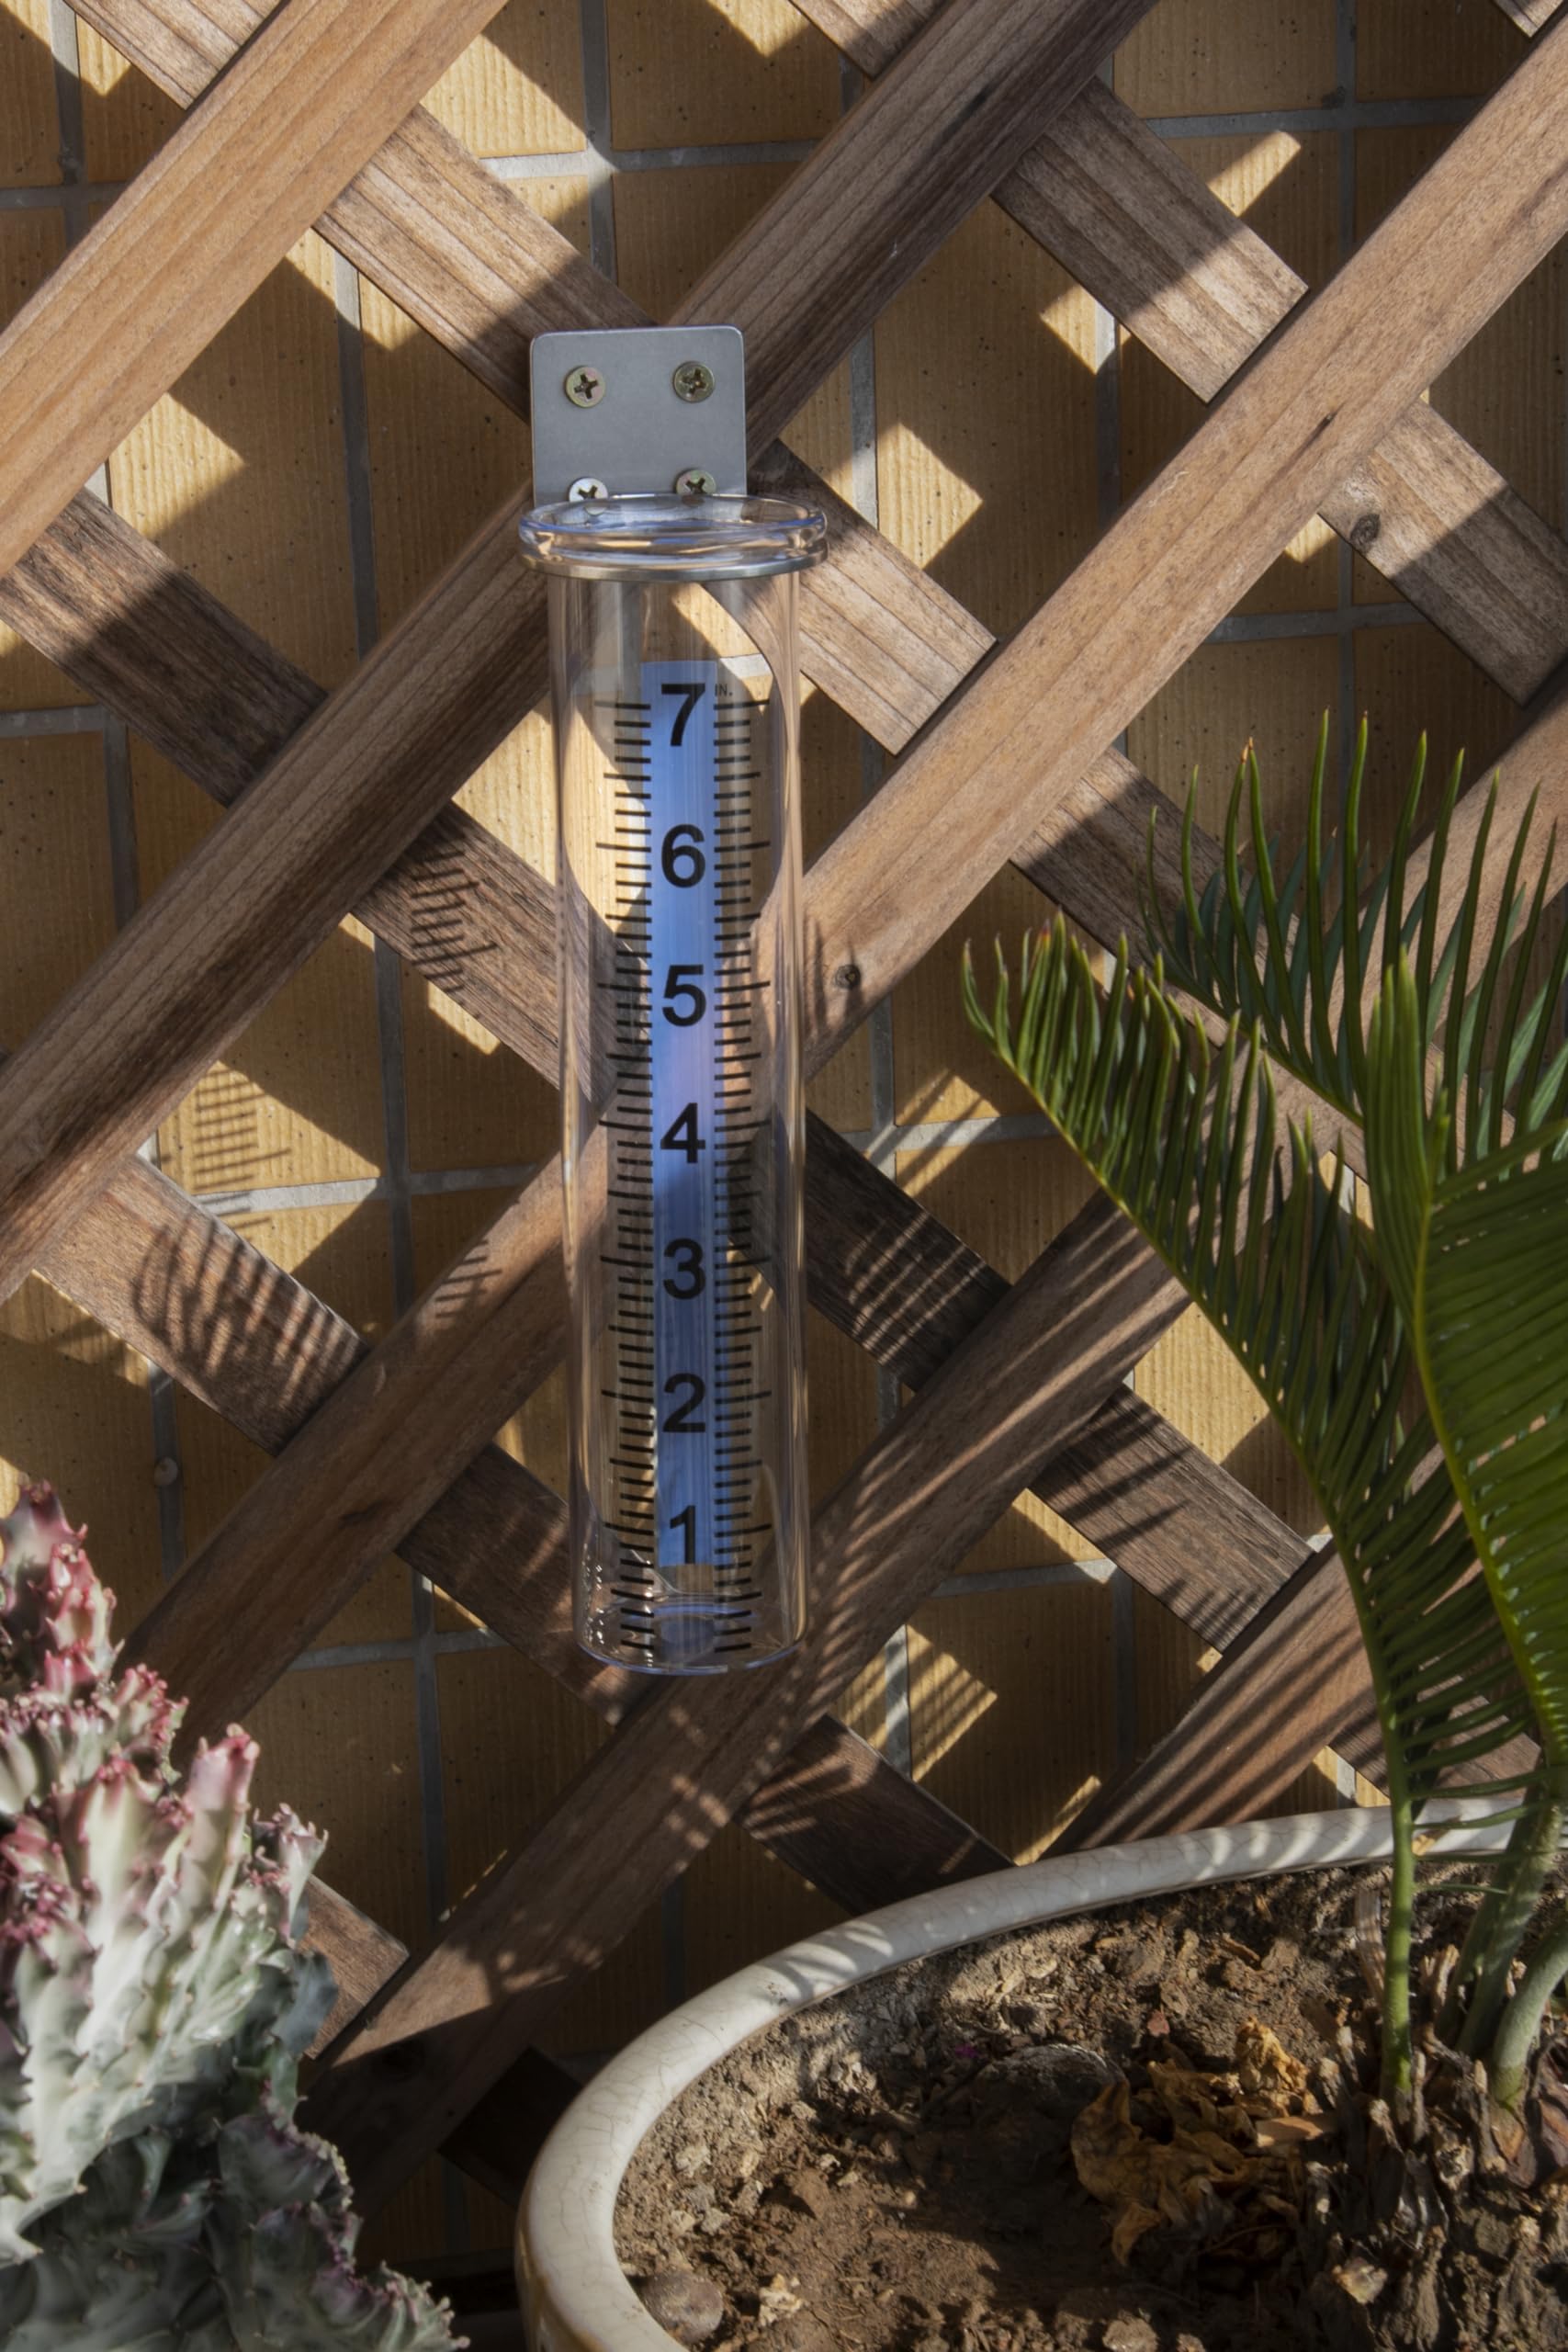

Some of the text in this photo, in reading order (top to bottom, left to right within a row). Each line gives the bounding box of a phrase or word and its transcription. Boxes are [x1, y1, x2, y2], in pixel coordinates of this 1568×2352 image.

[661, 683, 705, 746] 7
[661, 824, 705, 888] 6
[662, 965, 705, 1026] 5
[660, 1102, 705, 1164] 4
[663, 1238, 705, 1300] 3
[662, 1373, 705, 1433] 2
[670, 1505, 695, 1564] 1
